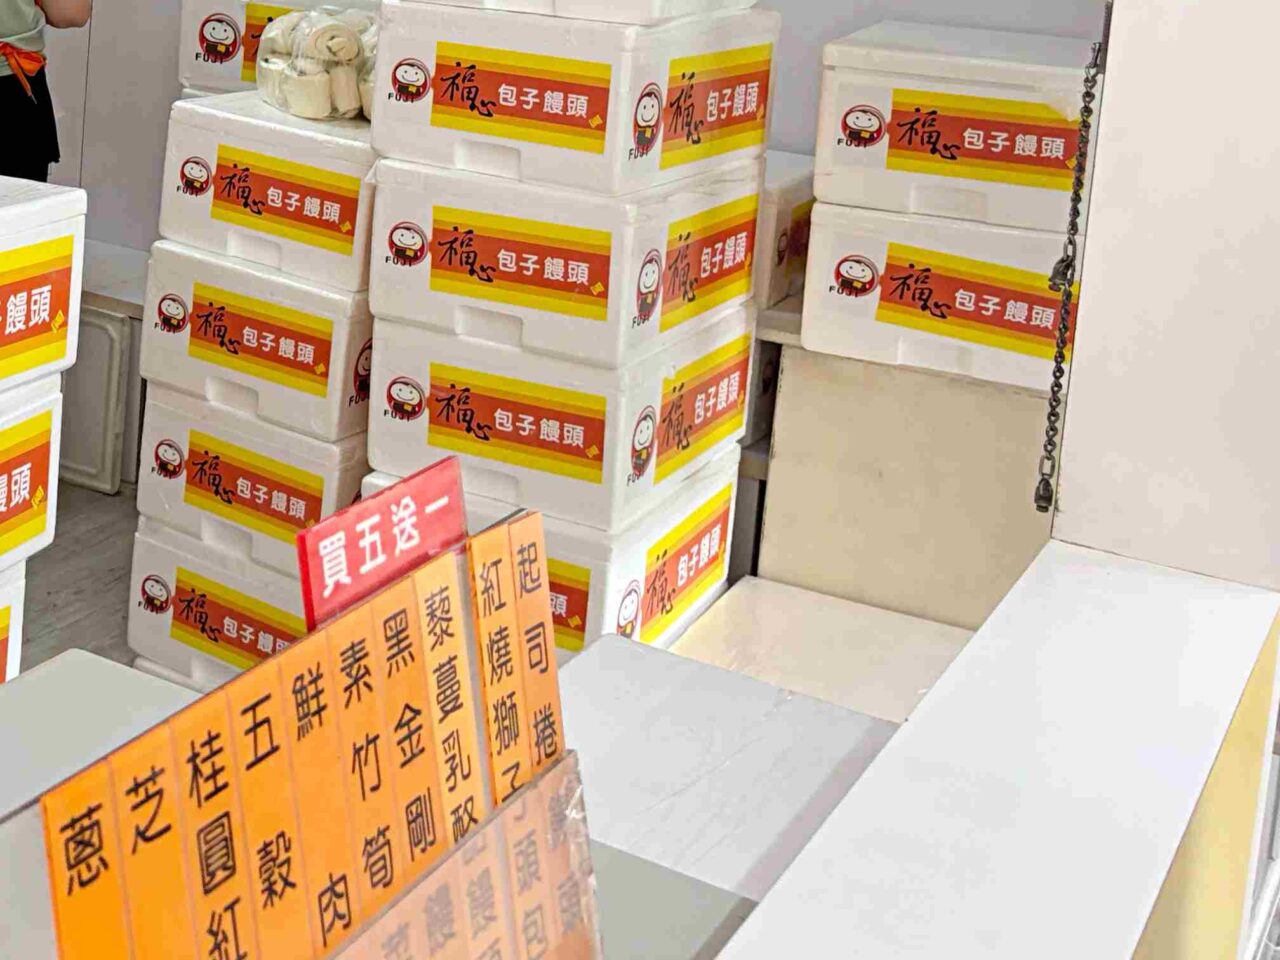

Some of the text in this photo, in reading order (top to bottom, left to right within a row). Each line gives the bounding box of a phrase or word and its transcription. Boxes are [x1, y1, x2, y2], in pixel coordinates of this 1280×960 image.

[498, 83, 589, 119] 包子饅頭
[706, 82, 760, 123] 包子饅頭
[962, 127, 1066, 160] 包子饅頭
[266, 187, 341, 224] 包子饅頭
[497, 249, 589, 285] 包子饅頭
[700, 231, 748, 278] 包子饅頭
[954, 288, 1056, 330] 包子饅頭
[242, 326, 315, 365] 包子饅頭
[494, 408, 585, 449] 包子饅頭
[236, 477, 307, 520] 包子饅頭
[318, 495, 450, 598] 買五送一
[125, 765, 172, 855] 芝
[60, 803, 109, 896] 蔥
